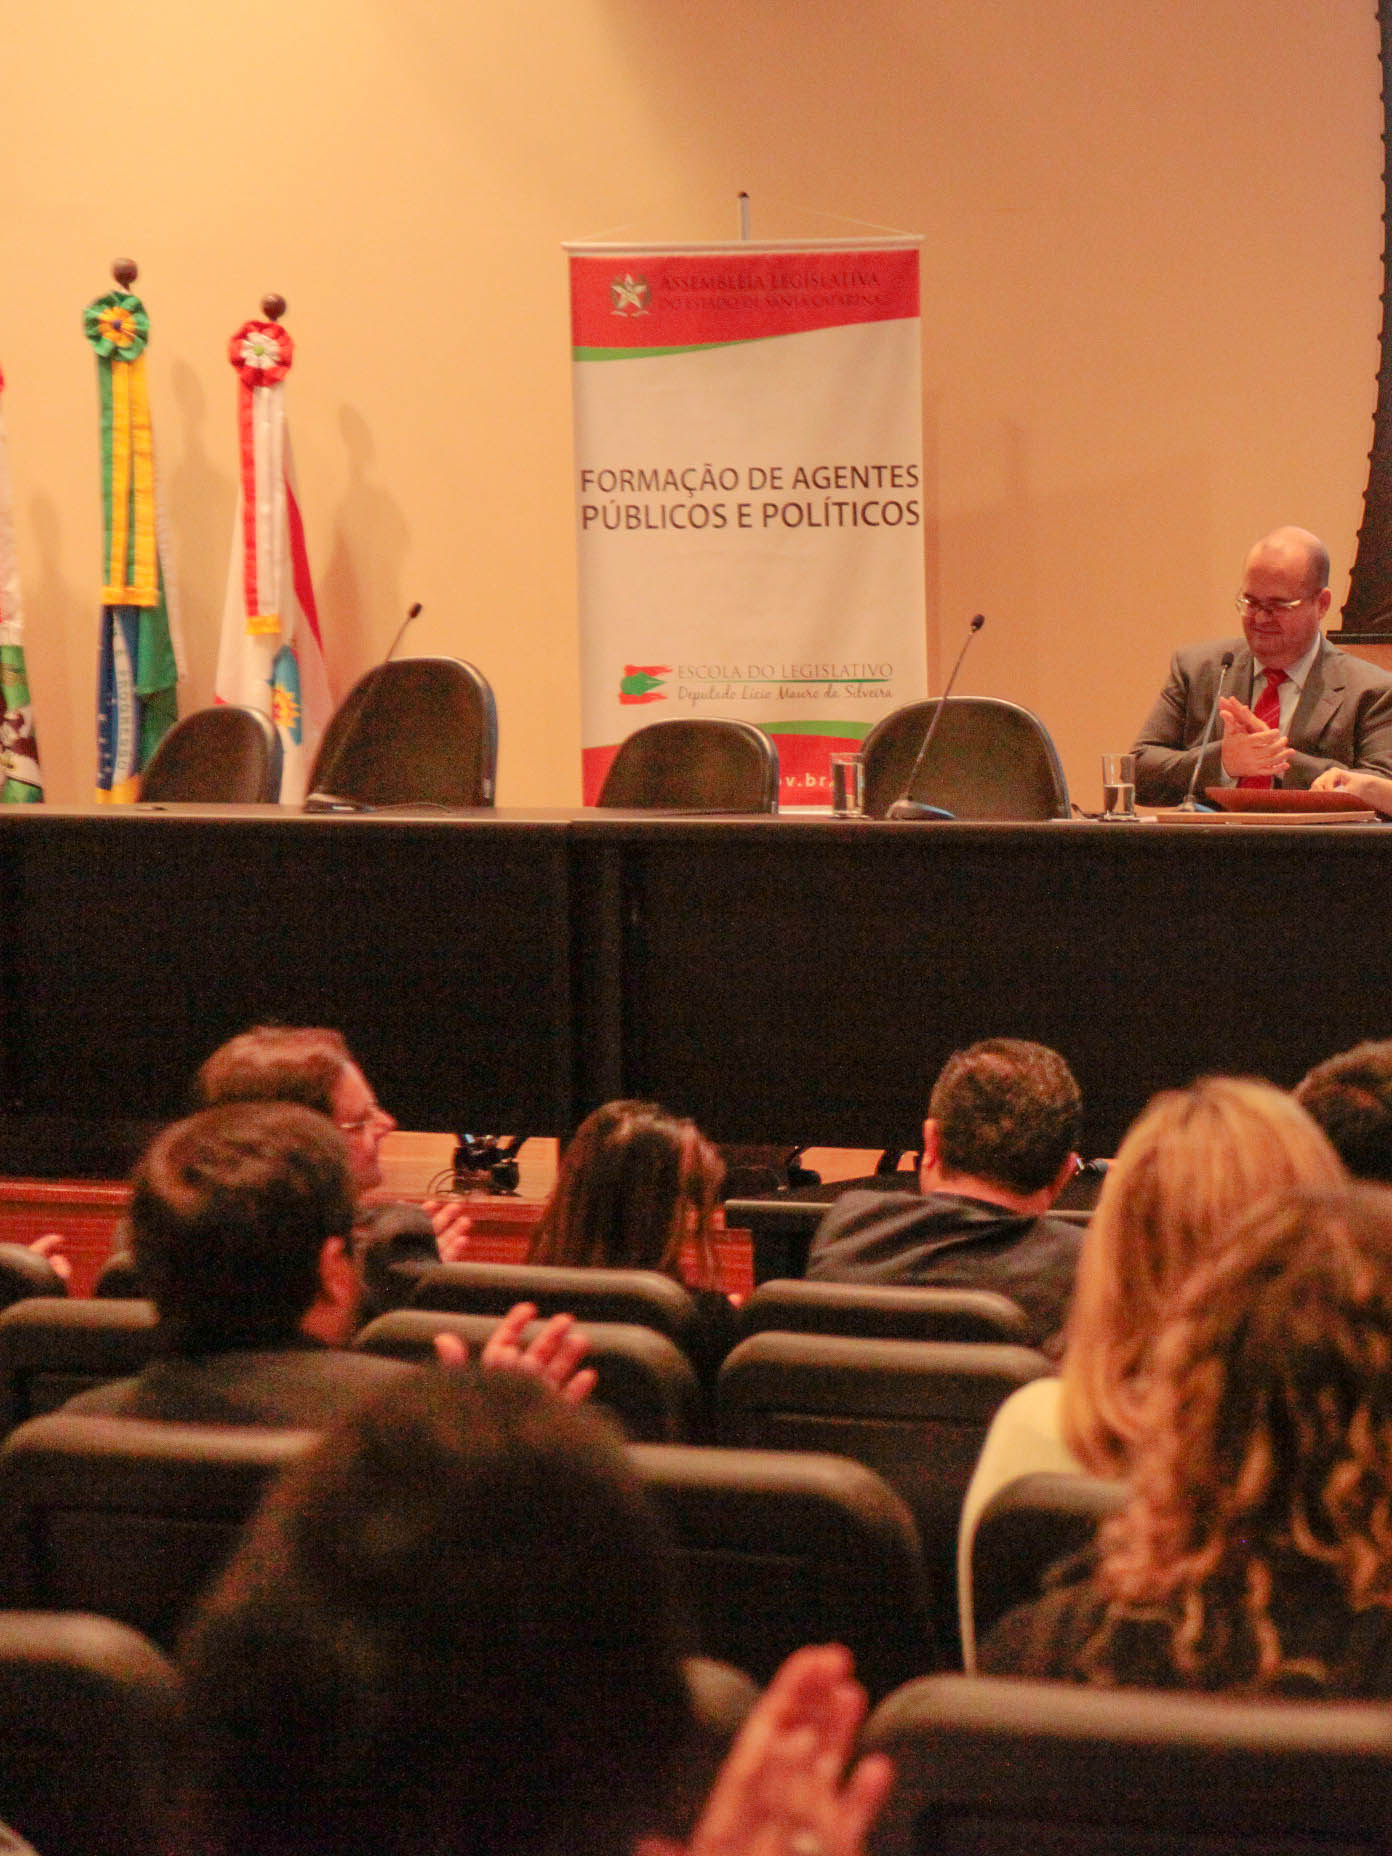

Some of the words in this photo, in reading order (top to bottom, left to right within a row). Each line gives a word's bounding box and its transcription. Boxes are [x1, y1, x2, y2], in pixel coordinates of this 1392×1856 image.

[580, 463, 739, 498] FORMAÇÃO
[748, 466, 783, 491] DE
[791, 464, 920, 491] AGENTES
[581, 499, 728, 530] PÚBLICOS
[737, 503, 753, 528] E
[762, 496, 920, 528] POLÍTICOS
[678, 664, 742, 680] ESCOLA
[748, 664, 776, 679] DO
[782, 663, 894, 679] LEGISLATIVO
